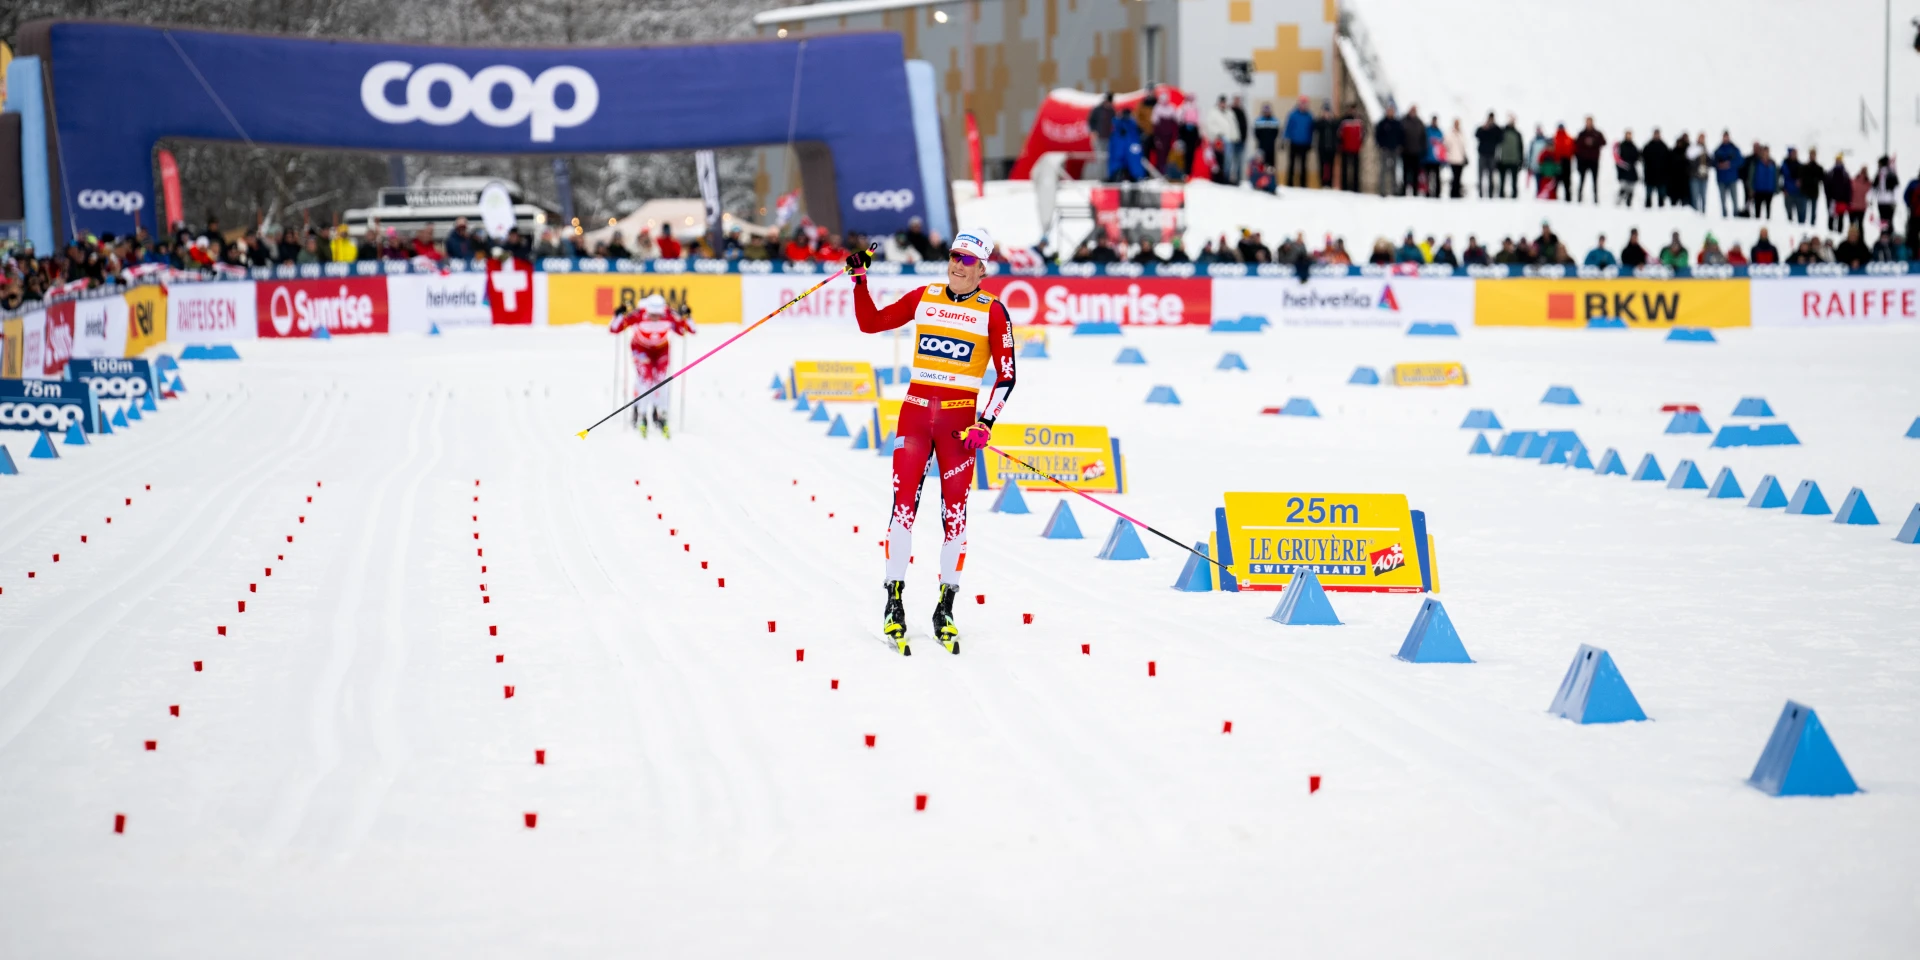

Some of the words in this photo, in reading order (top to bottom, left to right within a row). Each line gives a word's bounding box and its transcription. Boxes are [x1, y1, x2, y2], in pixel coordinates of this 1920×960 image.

[360, 60, 599, 142] coop
[78, 189, 144, 214] coop
[853, 188, 914, 212] coop
[294, 284, 373, 332] Sunrise
[426, 286, 477, 309] helvetia
[1044, 284, 1185, 326] Sunrise
[1282, 287, 1372, 309] helvetia
[1584, 293, 1680, 322] BKW
[1802, 289, 1916, 318] RAIFFE
[177, 298, 236, 332] RAIFFEISEN
[938, 309, 977, 324] Sunrise
[920, 337, 970, 358] coop
[92, 359, 133, 373] 100m
[920, 372, 947, 381] GOMS.CH
[23, 381, 62, 397] 75m
[1024, 428, 1074, 446] 50m
[943, 459, 970, 480] CRAFT
[998, 456, 1014, 470] LE
[1286, 497, 1358, 523] 25m
[1250, 538, 1271, 560] LE
[1278, 534, 1367, 561] GRUYÈRE
[1254, 564, 1362, 575] SWITZRLAND
[1372, 553, 1404, 572] AOP
